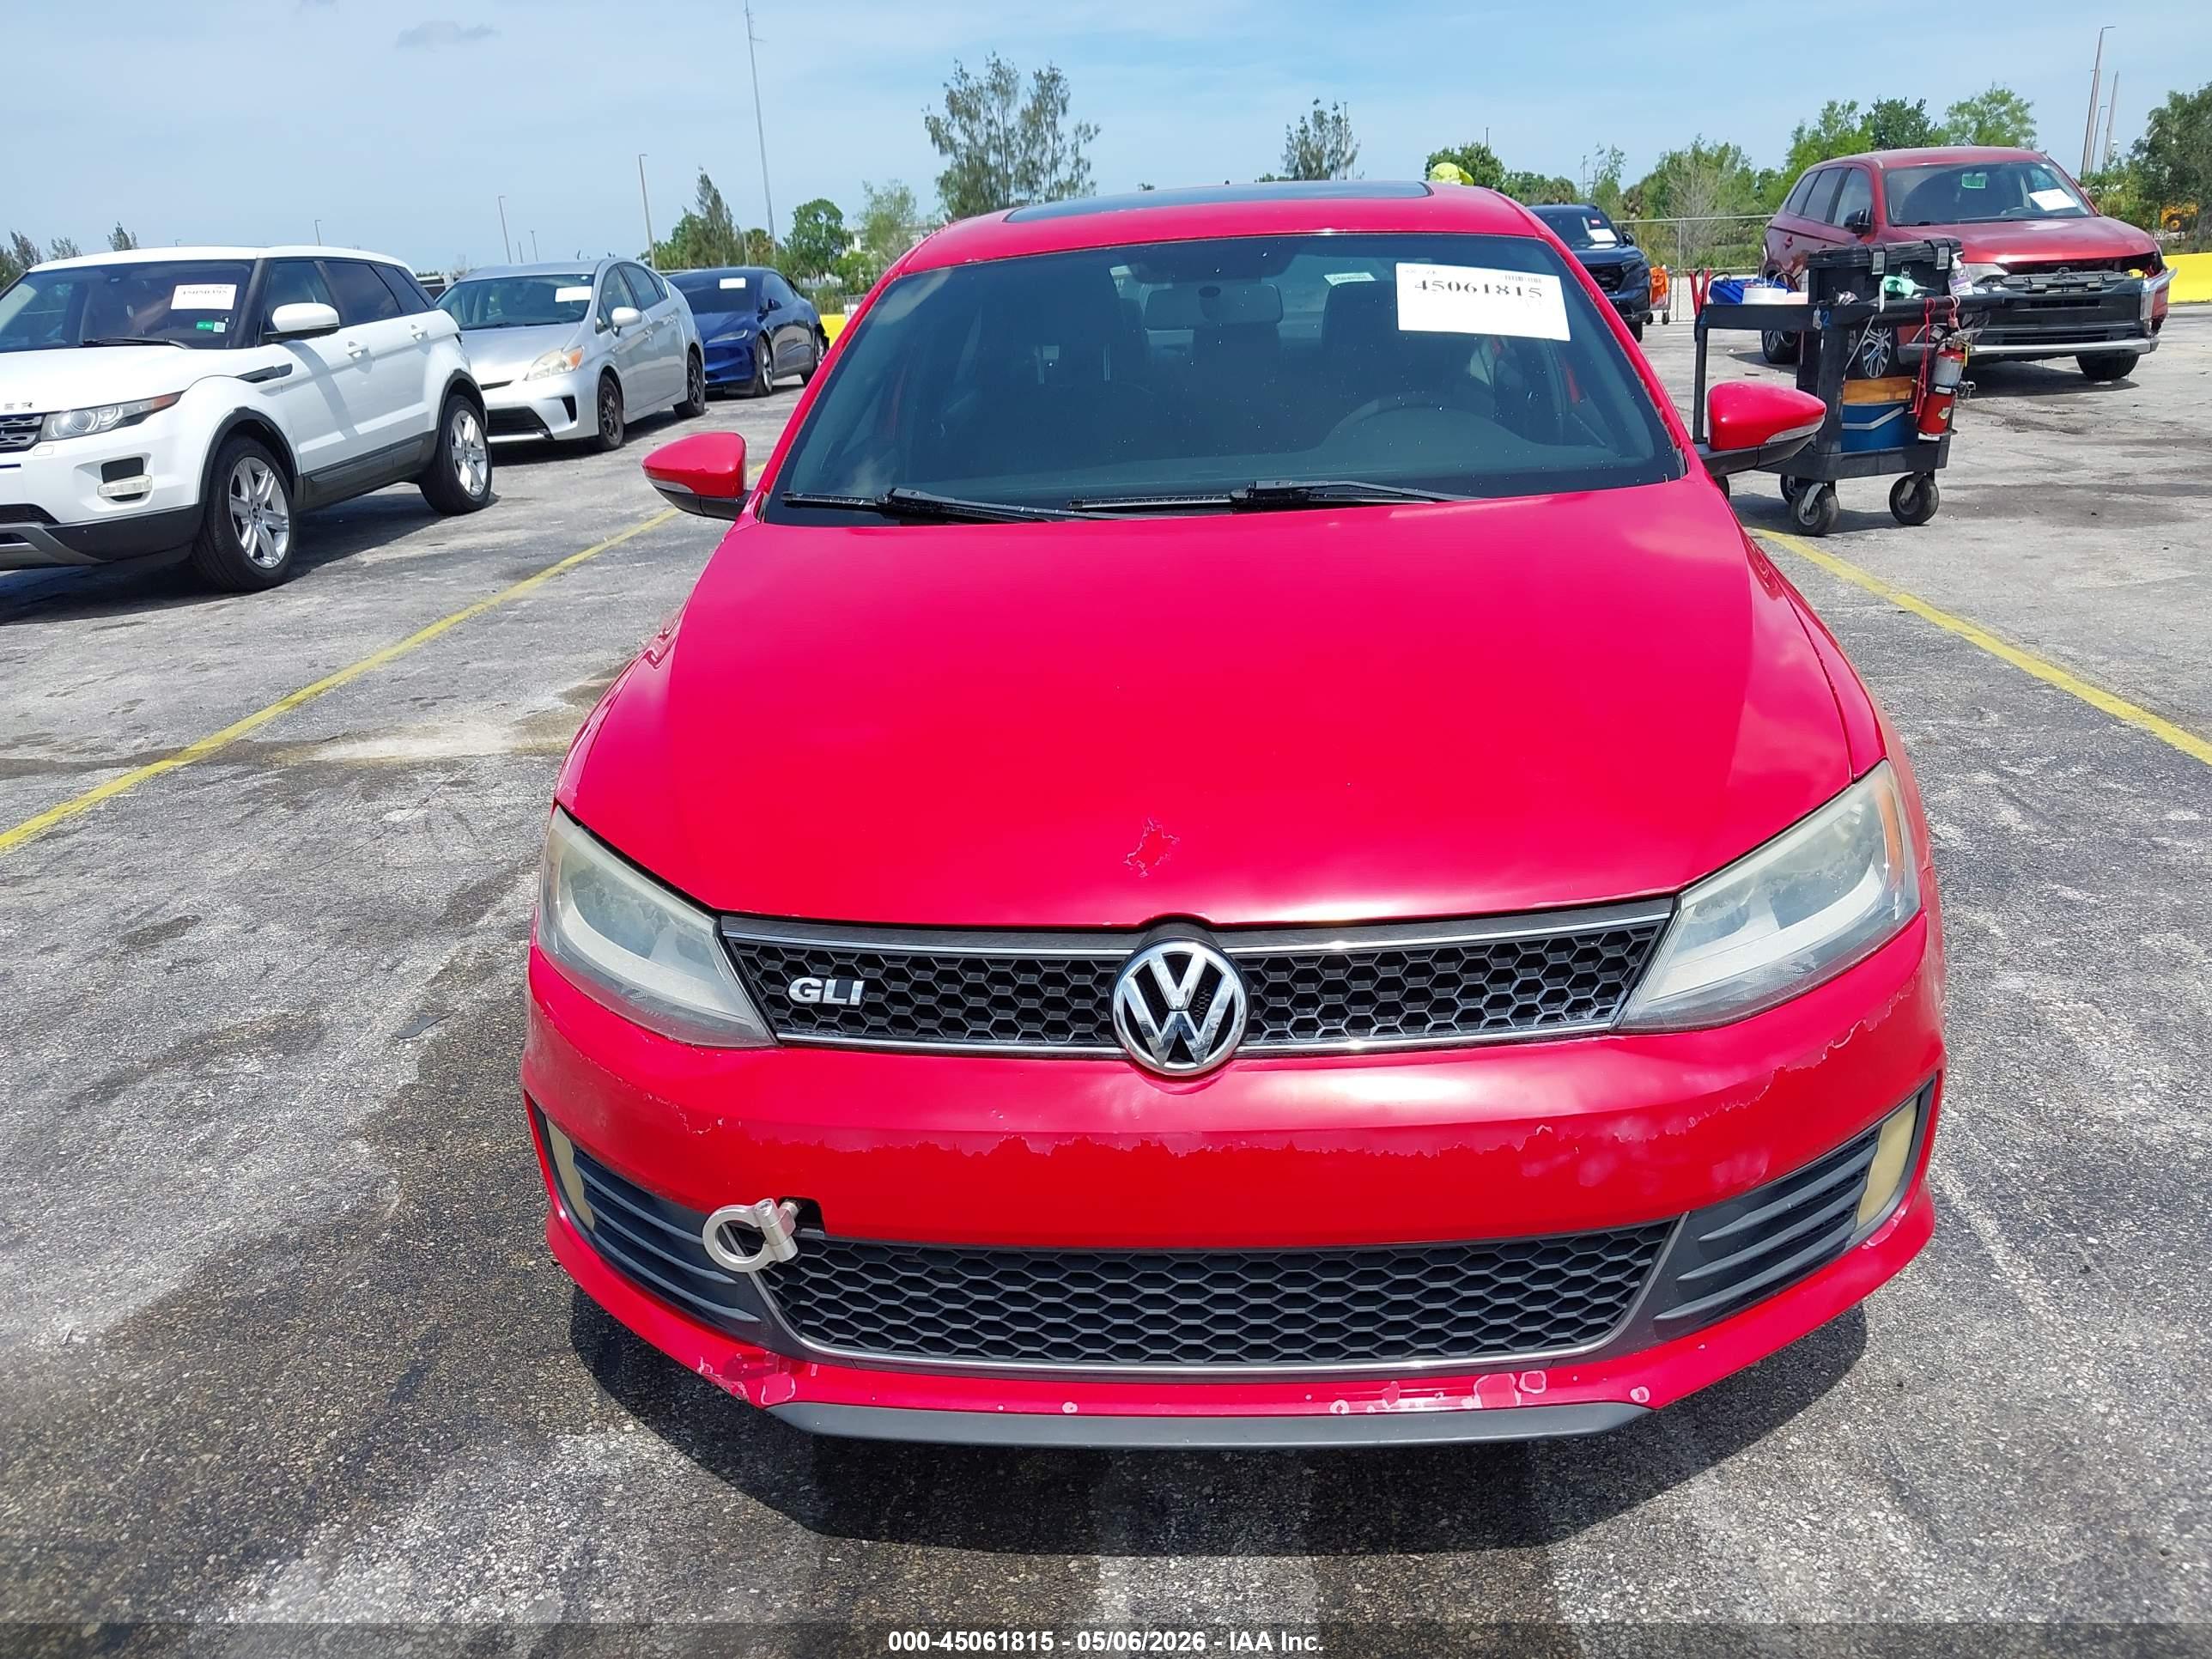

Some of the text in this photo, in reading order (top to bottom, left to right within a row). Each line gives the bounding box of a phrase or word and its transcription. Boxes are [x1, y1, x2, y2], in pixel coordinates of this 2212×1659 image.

[1413, 279, 1543, 299] 45061815
[1821, 310, 1831, 325] 2
[788, 976, 866, 1006] GLI
